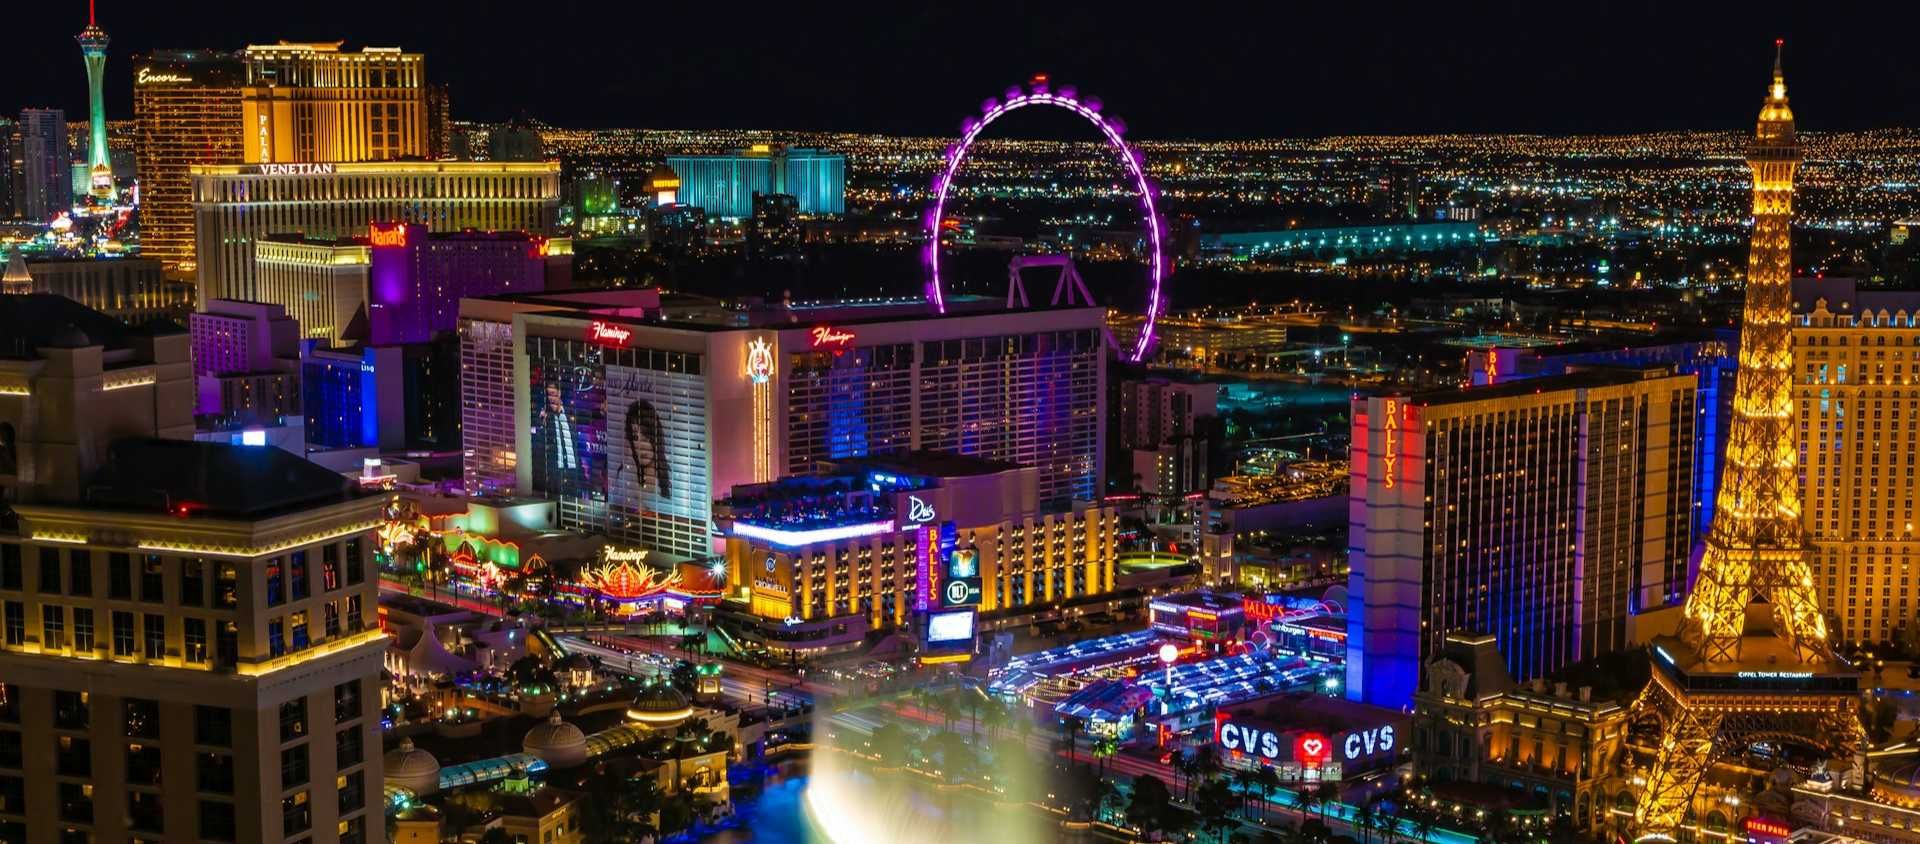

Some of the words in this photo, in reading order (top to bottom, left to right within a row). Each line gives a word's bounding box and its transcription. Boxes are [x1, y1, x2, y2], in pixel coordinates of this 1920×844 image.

[138, 68, 192, 84] Encore
[259, 115, 269, 163] PALA
[260, 164, 333, 175] VENETIAN
[593, 321, 631, 345] Flamingo
[604, 545, 649, 566] Flamingo
[1221, 723, 1279, 758] CVS
[1345, 725, 1394, 760] CVS
[1768, 825, 1788, 836] PARK
